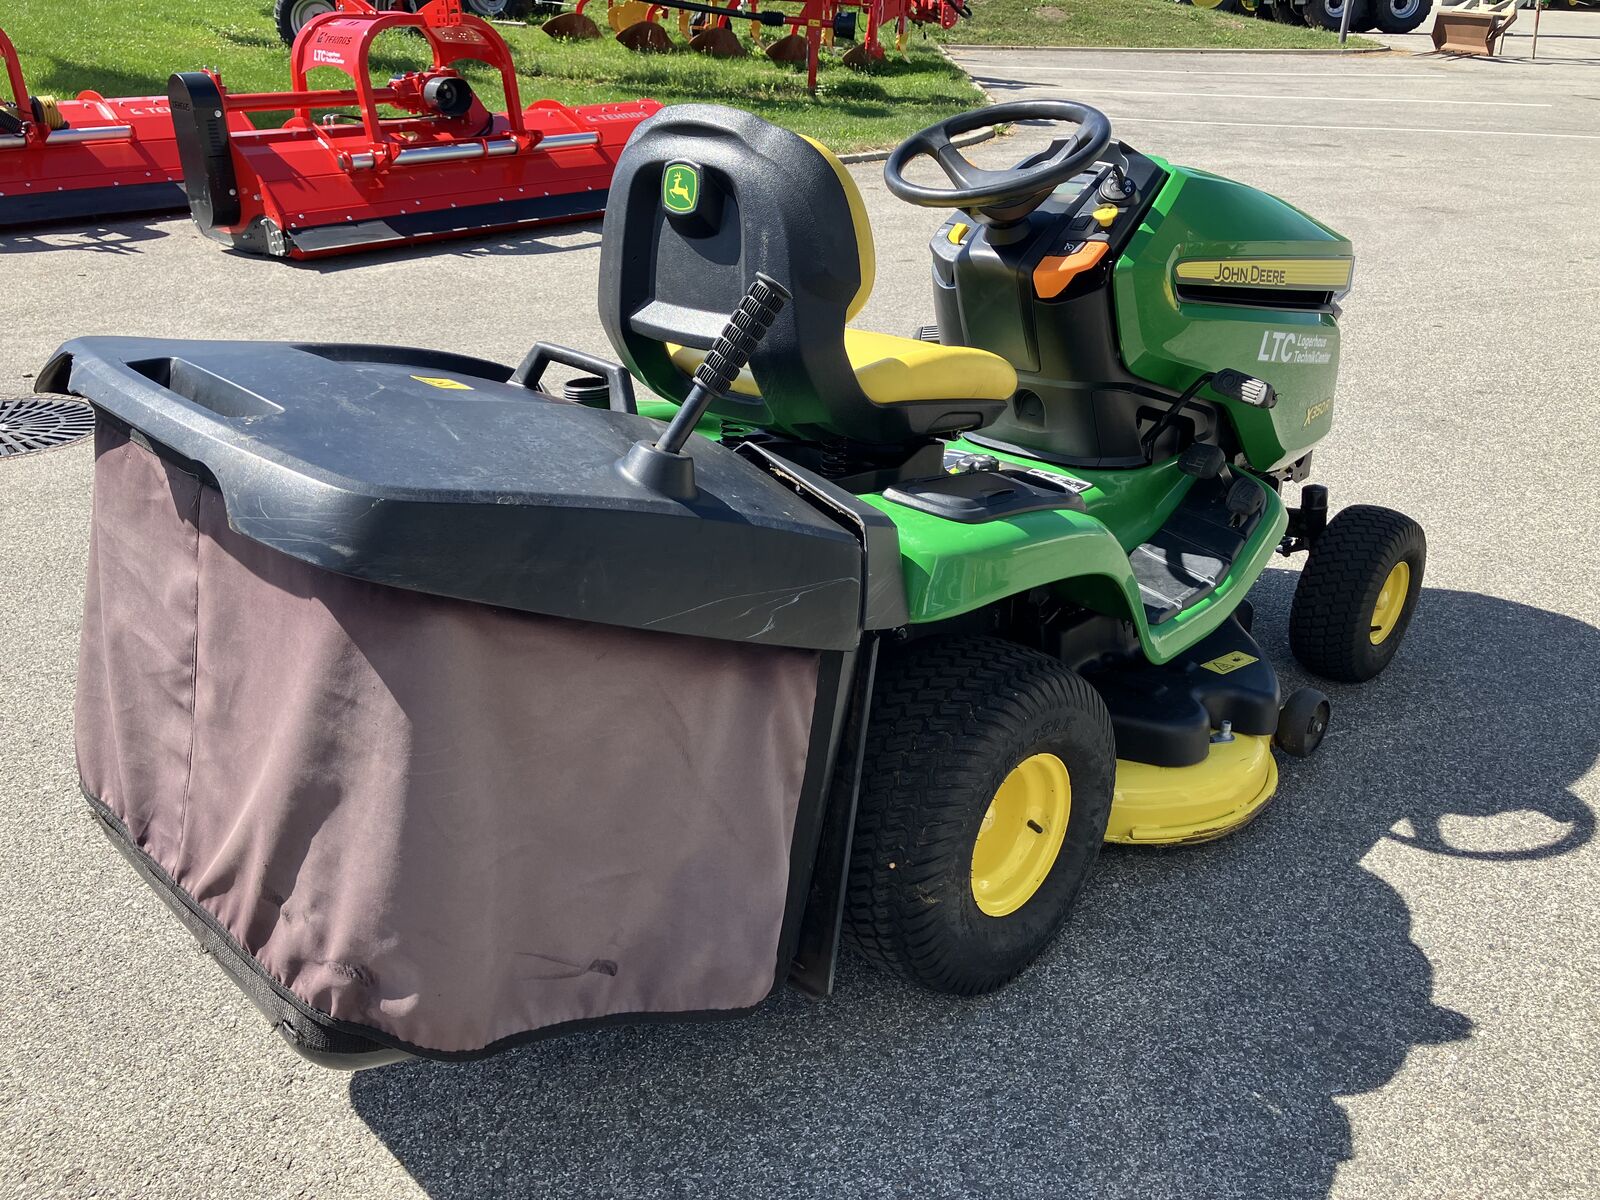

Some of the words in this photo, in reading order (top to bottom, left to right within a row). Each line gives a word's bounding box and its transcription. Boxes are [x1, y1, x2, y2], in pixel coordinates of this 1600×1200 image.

[325, 35, 353, 45] TEHNOS
[313, 49, 327, 62] LTC
[598, 111, 650, 121] TEHNOS
[1214, 262, 1249, 281] JOHN
[1250, 265, 1287, 284] DEERE
[1257, 330, 1296, 363] LTC
